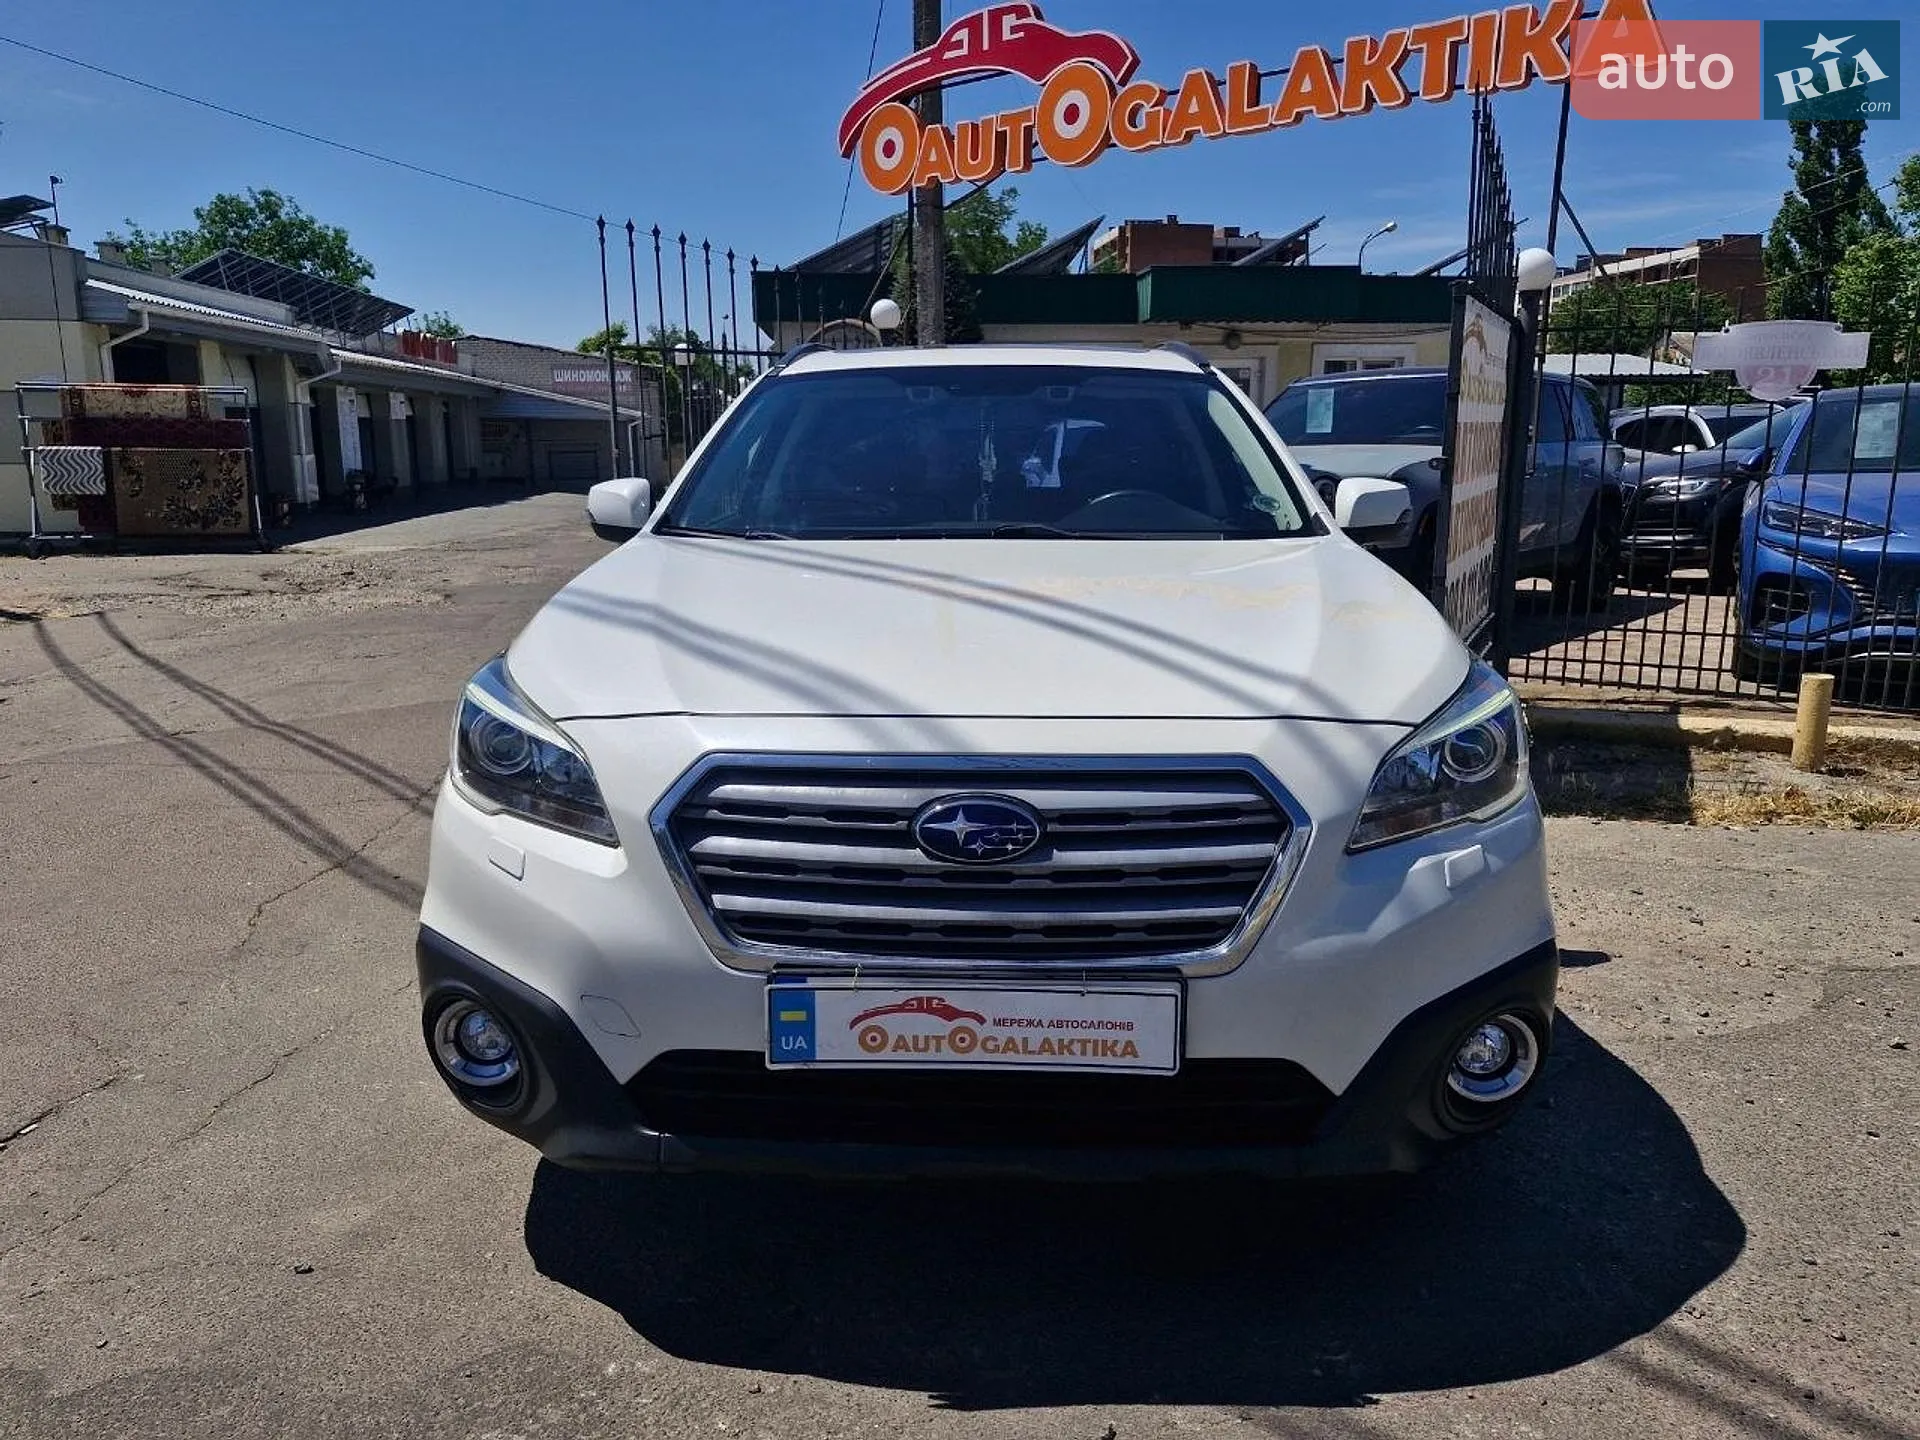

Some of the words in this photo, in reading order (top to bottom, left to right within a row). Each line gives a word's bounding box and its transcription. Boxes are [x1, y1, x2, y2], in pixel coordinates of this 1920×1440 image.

[554, 369, 632, 382] ШИНОМОНАЖ
[993, 1018, 1044, 1029] МЕРЕЖА
[1047, 1019, 1135, 1032] АВТОСАЛОНІВ
[780, 1035, 808, 1050] UA
